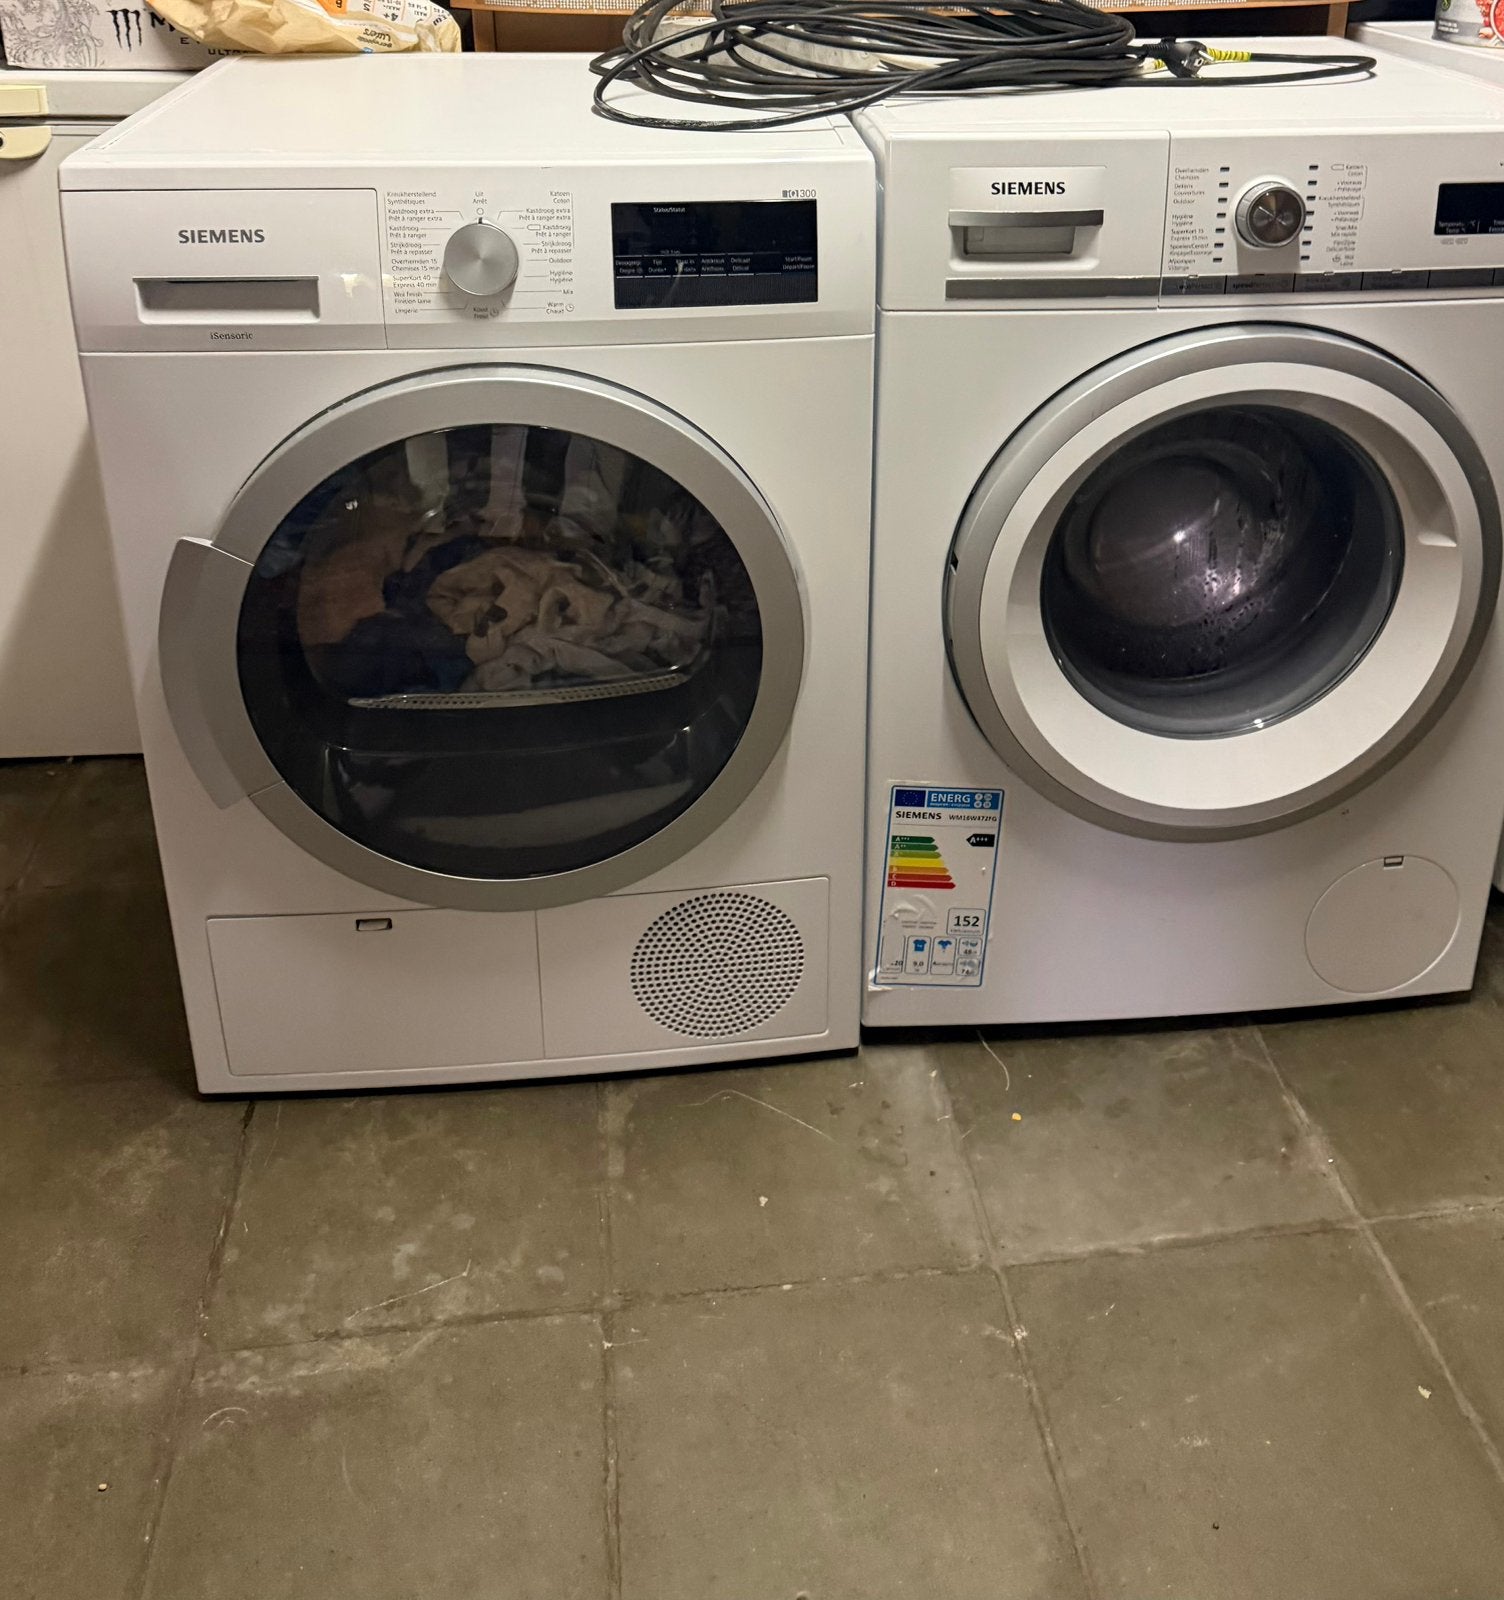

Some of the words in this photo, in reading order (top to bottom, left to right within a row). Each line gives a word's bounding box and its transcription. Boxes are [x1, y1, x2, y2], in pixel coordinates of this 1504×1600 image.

[383, 13, 398, 22] 4+
[991, 181, 1066, 195] SIEMENS
[178, 229, 265, 244] SIEMENS
[210, 331, 253, 340] iSensoric
[931, 793, 971, 803] ENERG
[896, 811, 942, 820] SIEMENS
[954, 915, 980, 927] 152
